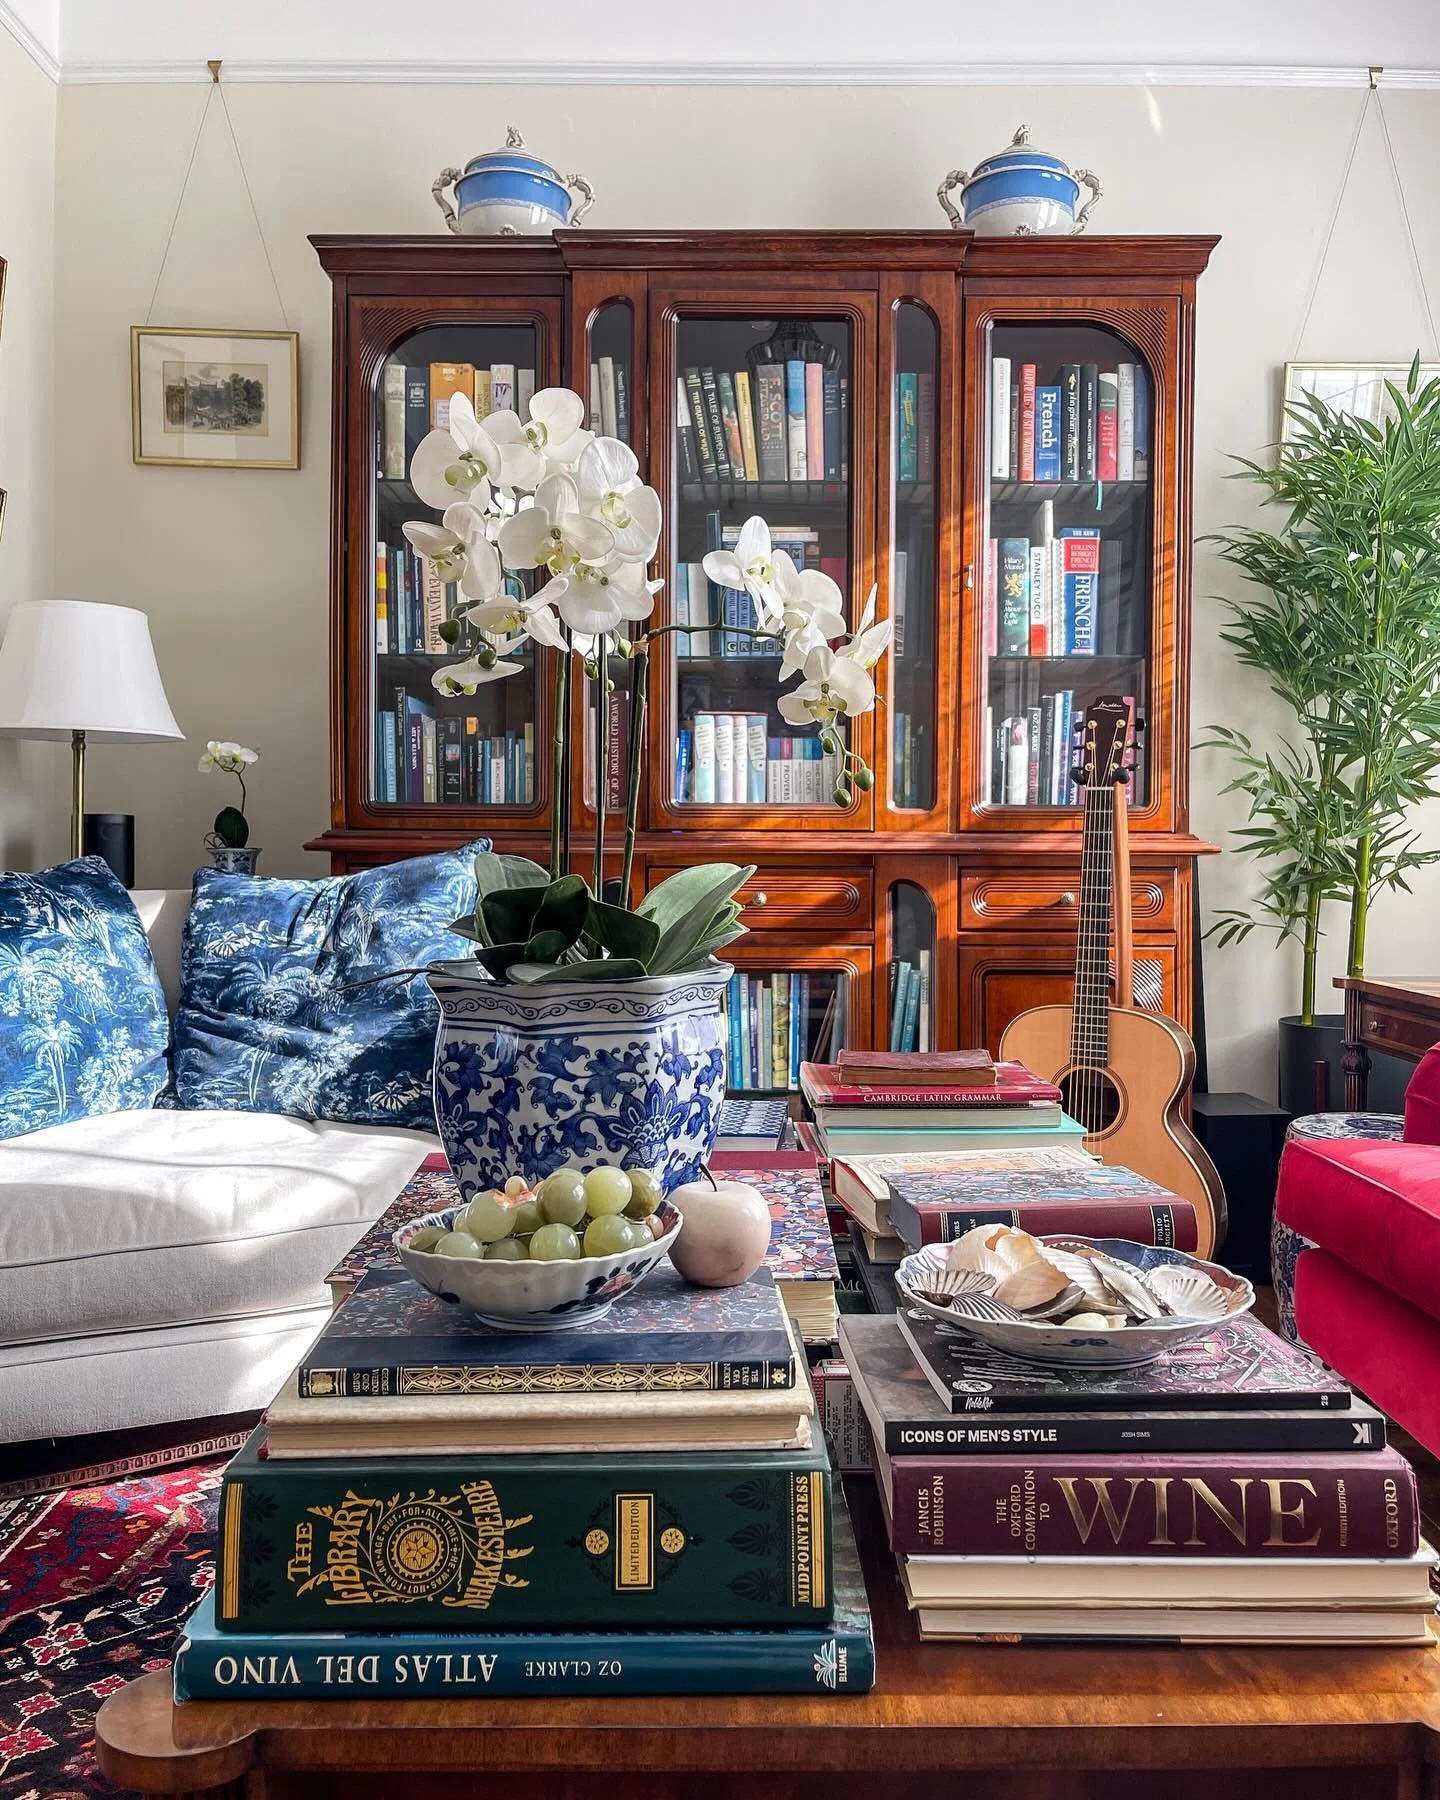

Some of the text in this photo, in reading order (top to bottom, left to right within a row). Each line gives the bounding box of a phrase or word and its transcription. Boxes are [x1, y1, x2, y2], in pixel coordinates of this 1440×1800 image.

[760, 378, 770, 441] FITZGERALD
[769, 392, 782, 440] SCOTT
[1042, 392, 1058, 449] French
[1075, 575, 1091, 639] FRENCH
[609, 704, 620, 735] WORLD
[1032, 713, 1038, 725] OZ
[609, 738, 620, 775] HISTORY
[610, 778, 620, 791] OF
[863, 1093, 1002, 1102] CAMBRIDGE LATIN GRAMMAR
[1321, 1395, 1328, 1406] 28
[901, 1429, 1057, 1443] ICONS OF MEN'S STYLE
[918, 1488, 931, 1535] JANCIS
[933, 1475, 944, 1546] ROBINSON
[996, 1498, 1006, 1523] THE
[1010, 1484, 1021, 1537] OXFORD
[1024, 1470, 1035, 1550] COMPANION
[1040, 1502, 1050, 1520] TO
[1053, 1477, 1322, 1546] WINE
[1336, 1480, 1346, 1514] EDITION
[1384, 1478, 1399, 1548] OXFORD
[288, 1522, 312, 1582] THE
[326, 1489, 378, 1606] LIBRARY
[375, 1507, 458, 1593] HE WAS NOT FOR AN AGE BUT FOR ALL TIME
[442, 1480, 505, 1610] SHAKESPEARE
[630, 1501, 640, 1583] LIMITED EDITION
[796, 1475, 810, 1604] MIDPOINT PRESS
[214, 1653, 499, 1684] ATLAS DEL VINO
[525, 1661, 622, 1677] OZ CLARKE
[839, 1646, 848, 1683] BLUME
